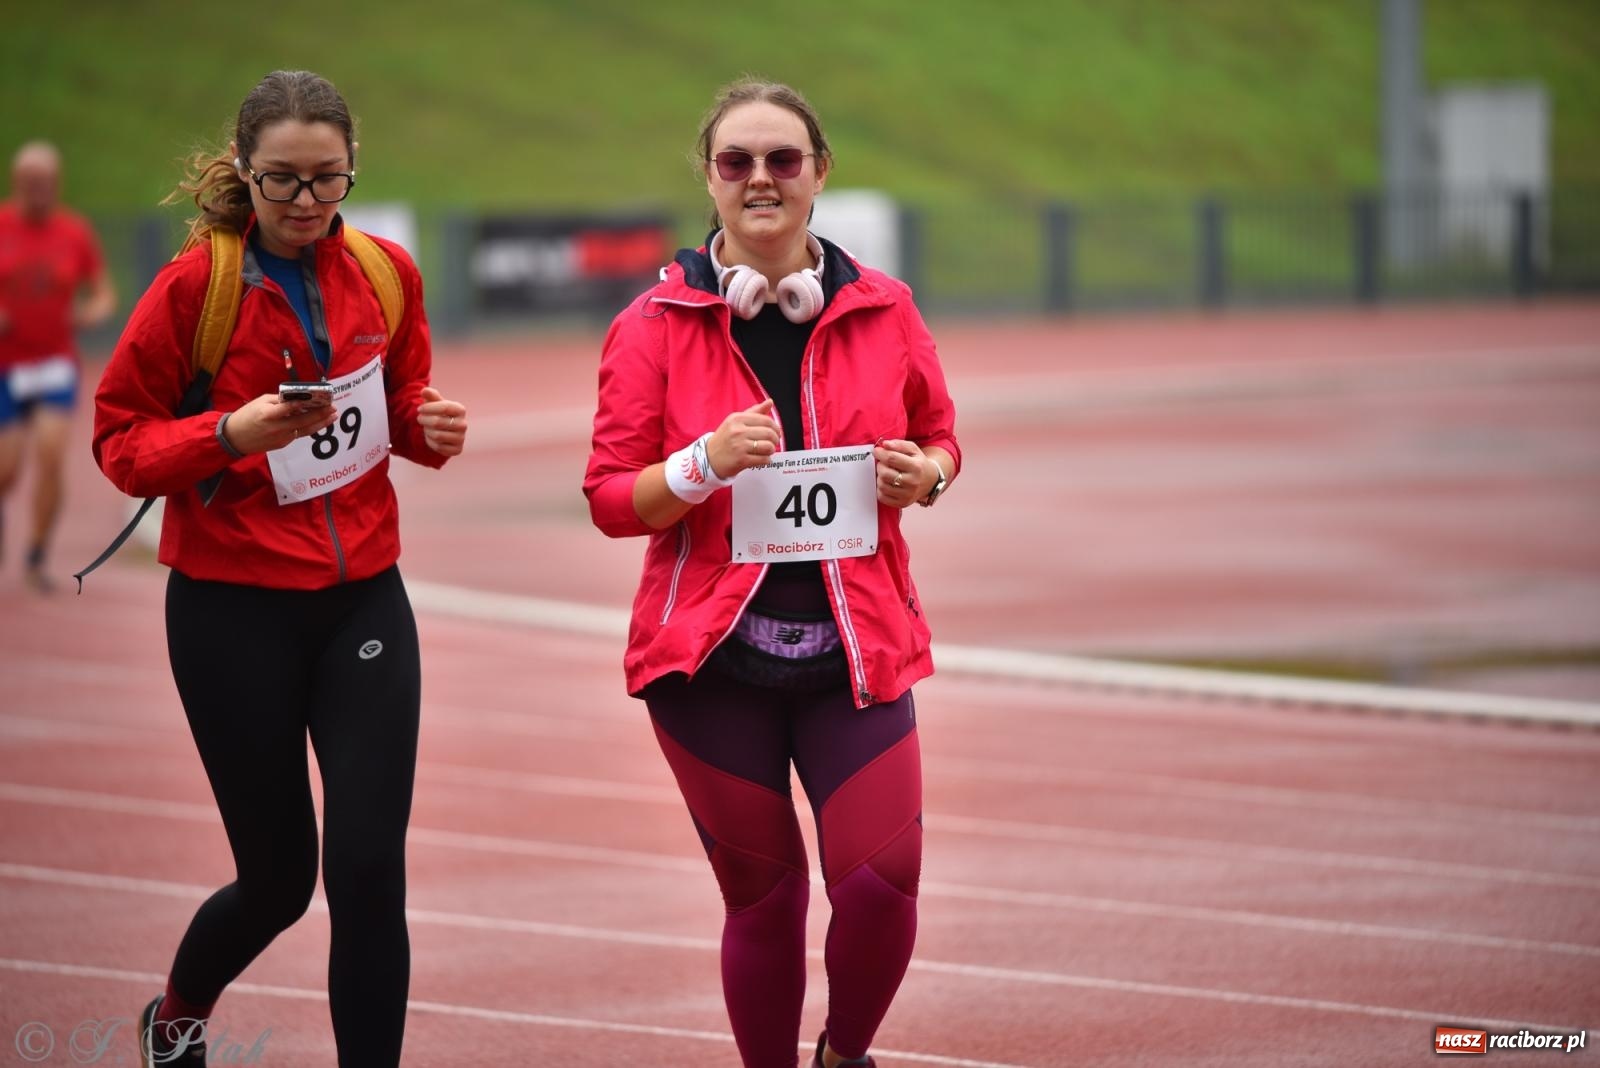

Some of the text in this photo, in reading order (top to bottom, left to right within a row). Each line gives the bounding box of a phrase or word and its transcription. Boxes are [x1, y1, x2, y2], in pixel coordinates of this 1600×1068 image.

[309, 406, 362, 460] 89
[784, 459, 796, 467] Fun
[801, 456, 829, 466] EASYRUN
[829, 455, 841, 463] 24h
[308, 462, 358, 489] Racibórz
[775, 482, 837, 528] 40
[767, 537, 863, 554] Racibórz OSiR
